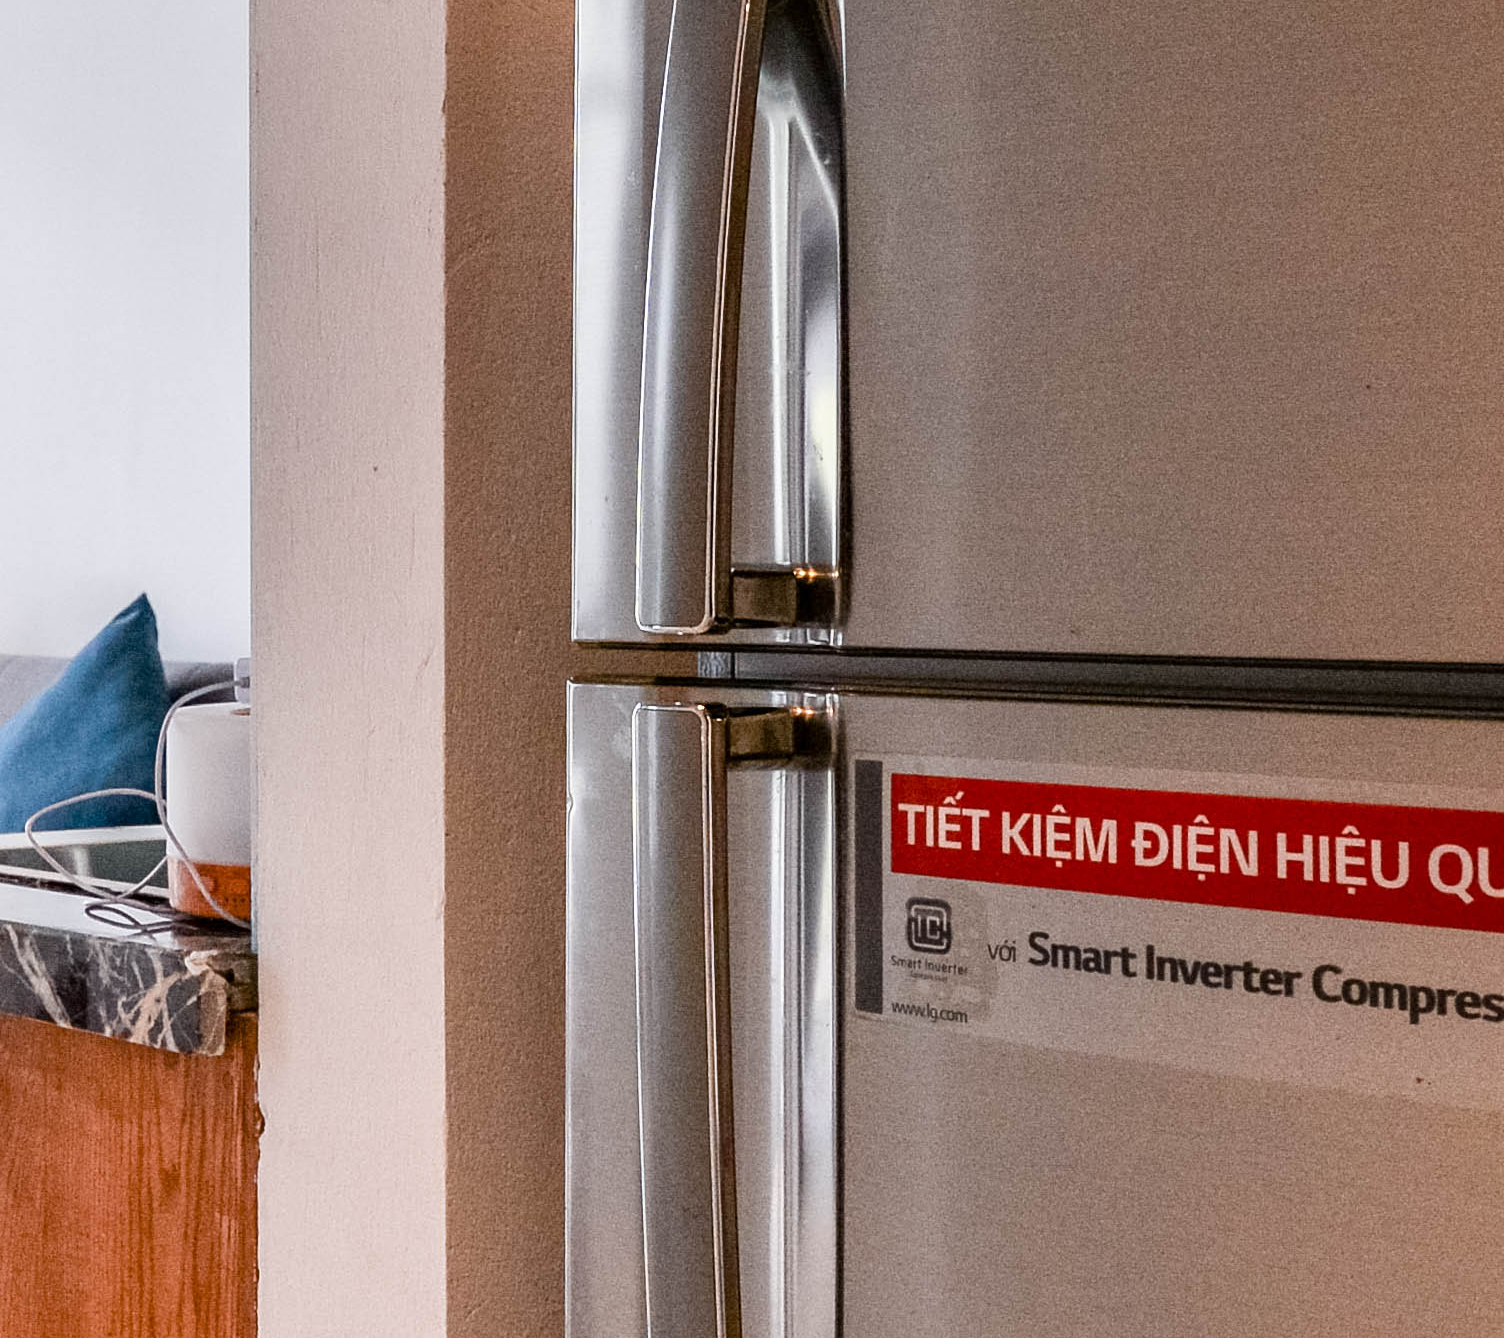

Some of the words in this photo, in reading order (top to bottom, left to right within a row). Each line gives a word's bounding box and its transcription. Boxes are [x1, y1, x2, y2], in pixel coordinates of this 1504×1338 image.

[898, 790, 990, 852] TIẾT
[1001, 804, 1118, 868] KIỆM
[1131, 814, 1259, 881] ĐIỆN
[1276, 825, 1410, 895] HIỆU
[891, 955, 922, 970] Smart
[925, 959, 968, 976] Inverter
[987, 939, 1017, 963] với
[1028, 931, 1138, 978] Smart
[1146, 944, 1303, 997] Inverter
[891, 1002, 968, 1023] www.lg.com
